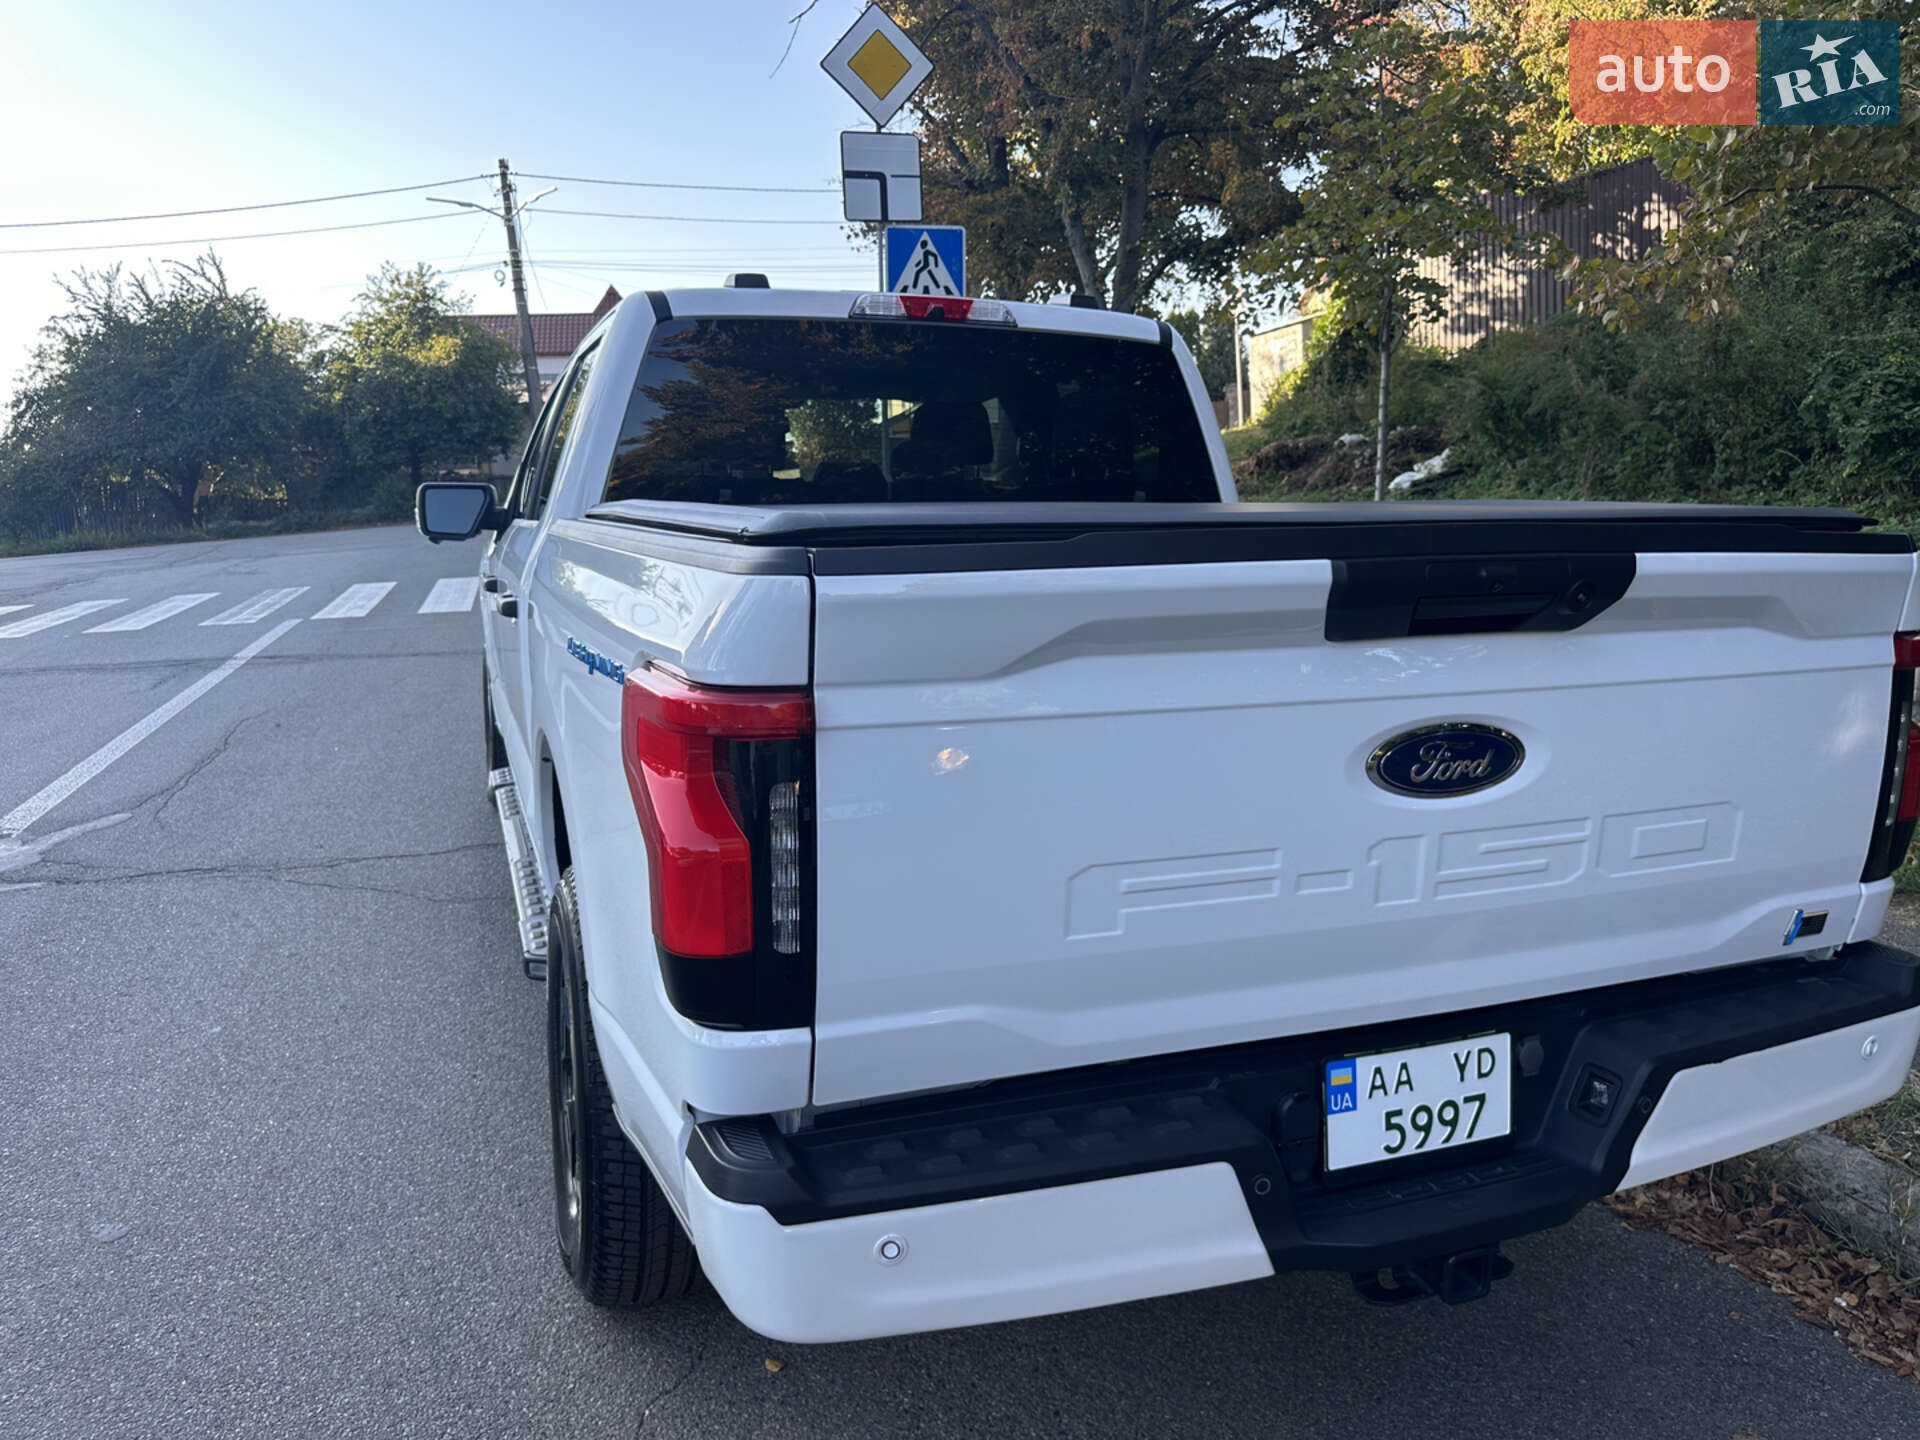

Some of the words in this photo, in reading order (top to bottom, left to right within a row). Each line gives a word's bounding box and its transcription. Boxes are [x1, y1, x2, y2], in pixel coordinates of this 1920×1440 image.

[1410, 740, 1496, 784] Ford
[1064, 800, 1744, 941] F-150
[1367, 1061, 1415, 1100] AA
[1453, 1046, 1497, 1083] YD
[1330, 1092, 1353, 1112] UA
[1382, 1092, 1487, 1155] 5997
